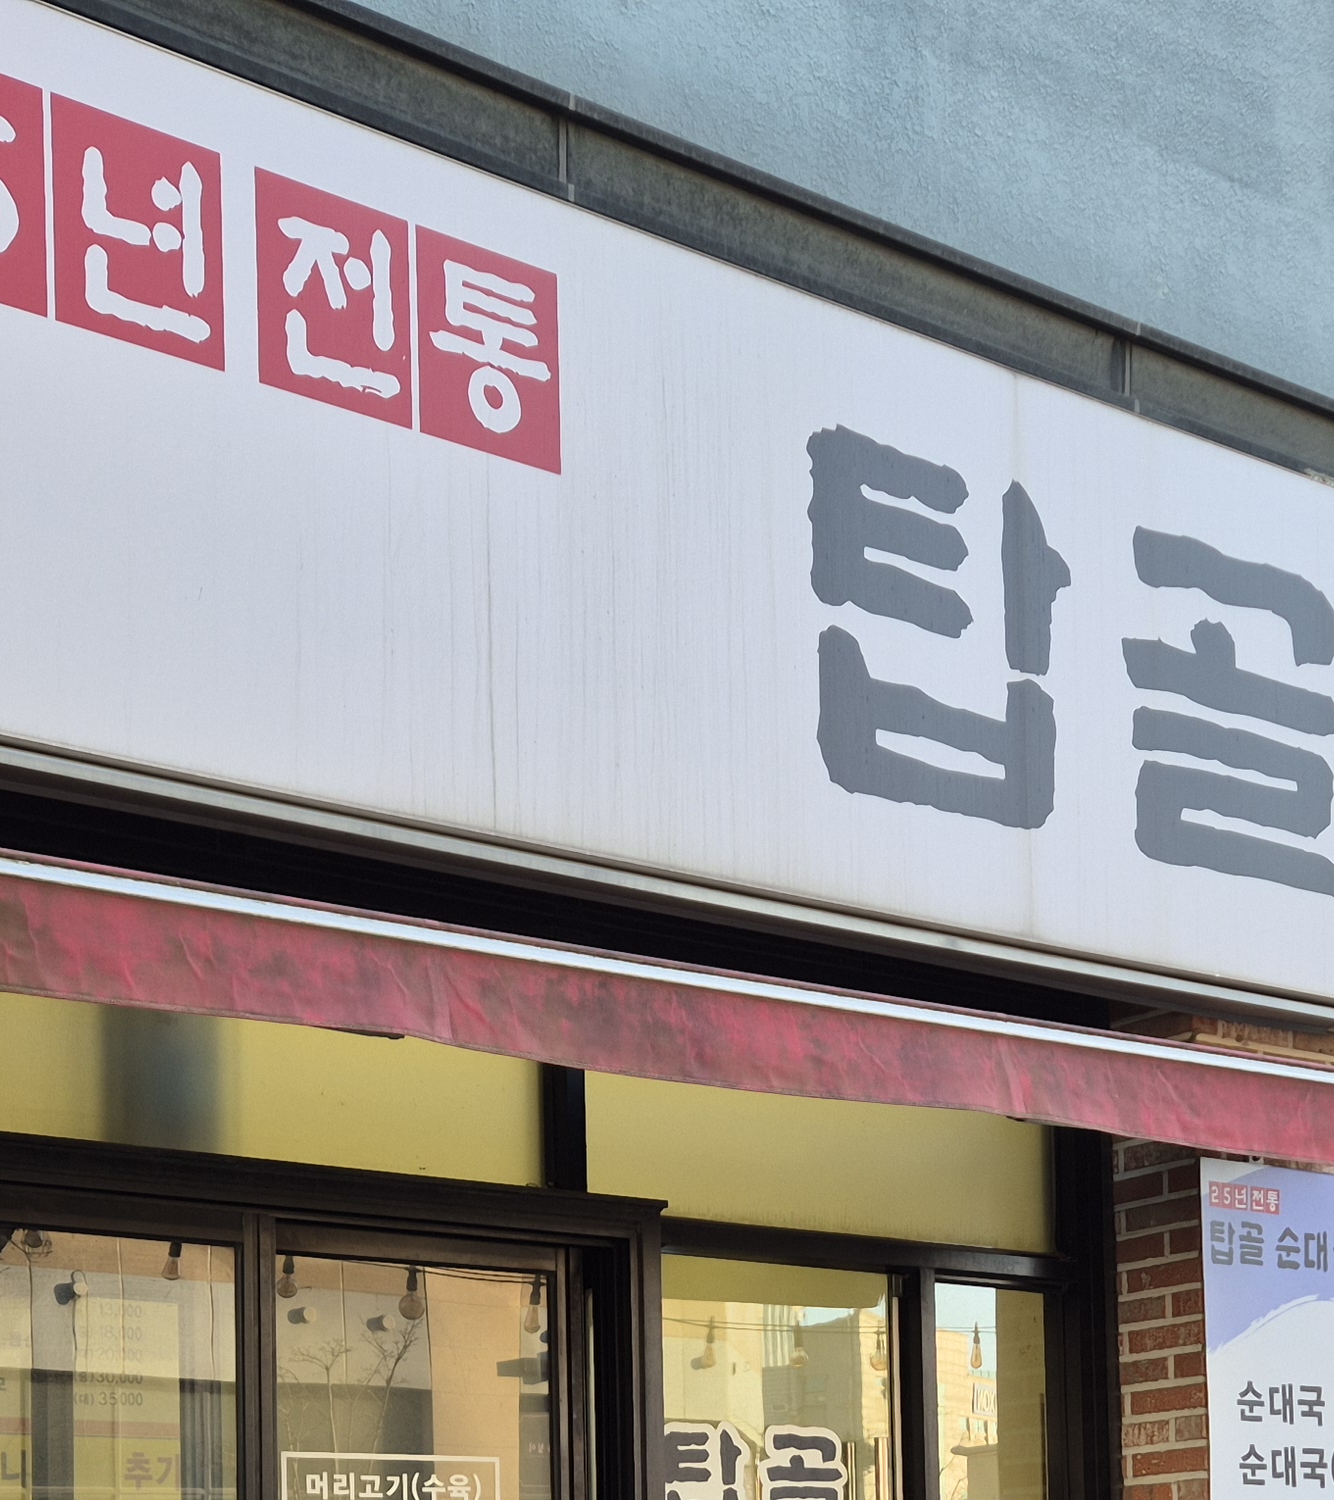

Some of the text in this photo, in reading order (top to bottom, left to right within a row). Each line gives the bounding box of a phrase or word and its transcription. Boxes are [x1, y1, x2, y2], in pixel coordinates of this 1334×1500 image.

[277, 215, 550, 433] 전통
[1210, 1185, 1280, 1212] 25년 전통
[1209, 1220, 1265, 1266] 탑골
[1236, 1380, 1326, 1427] 순대국
